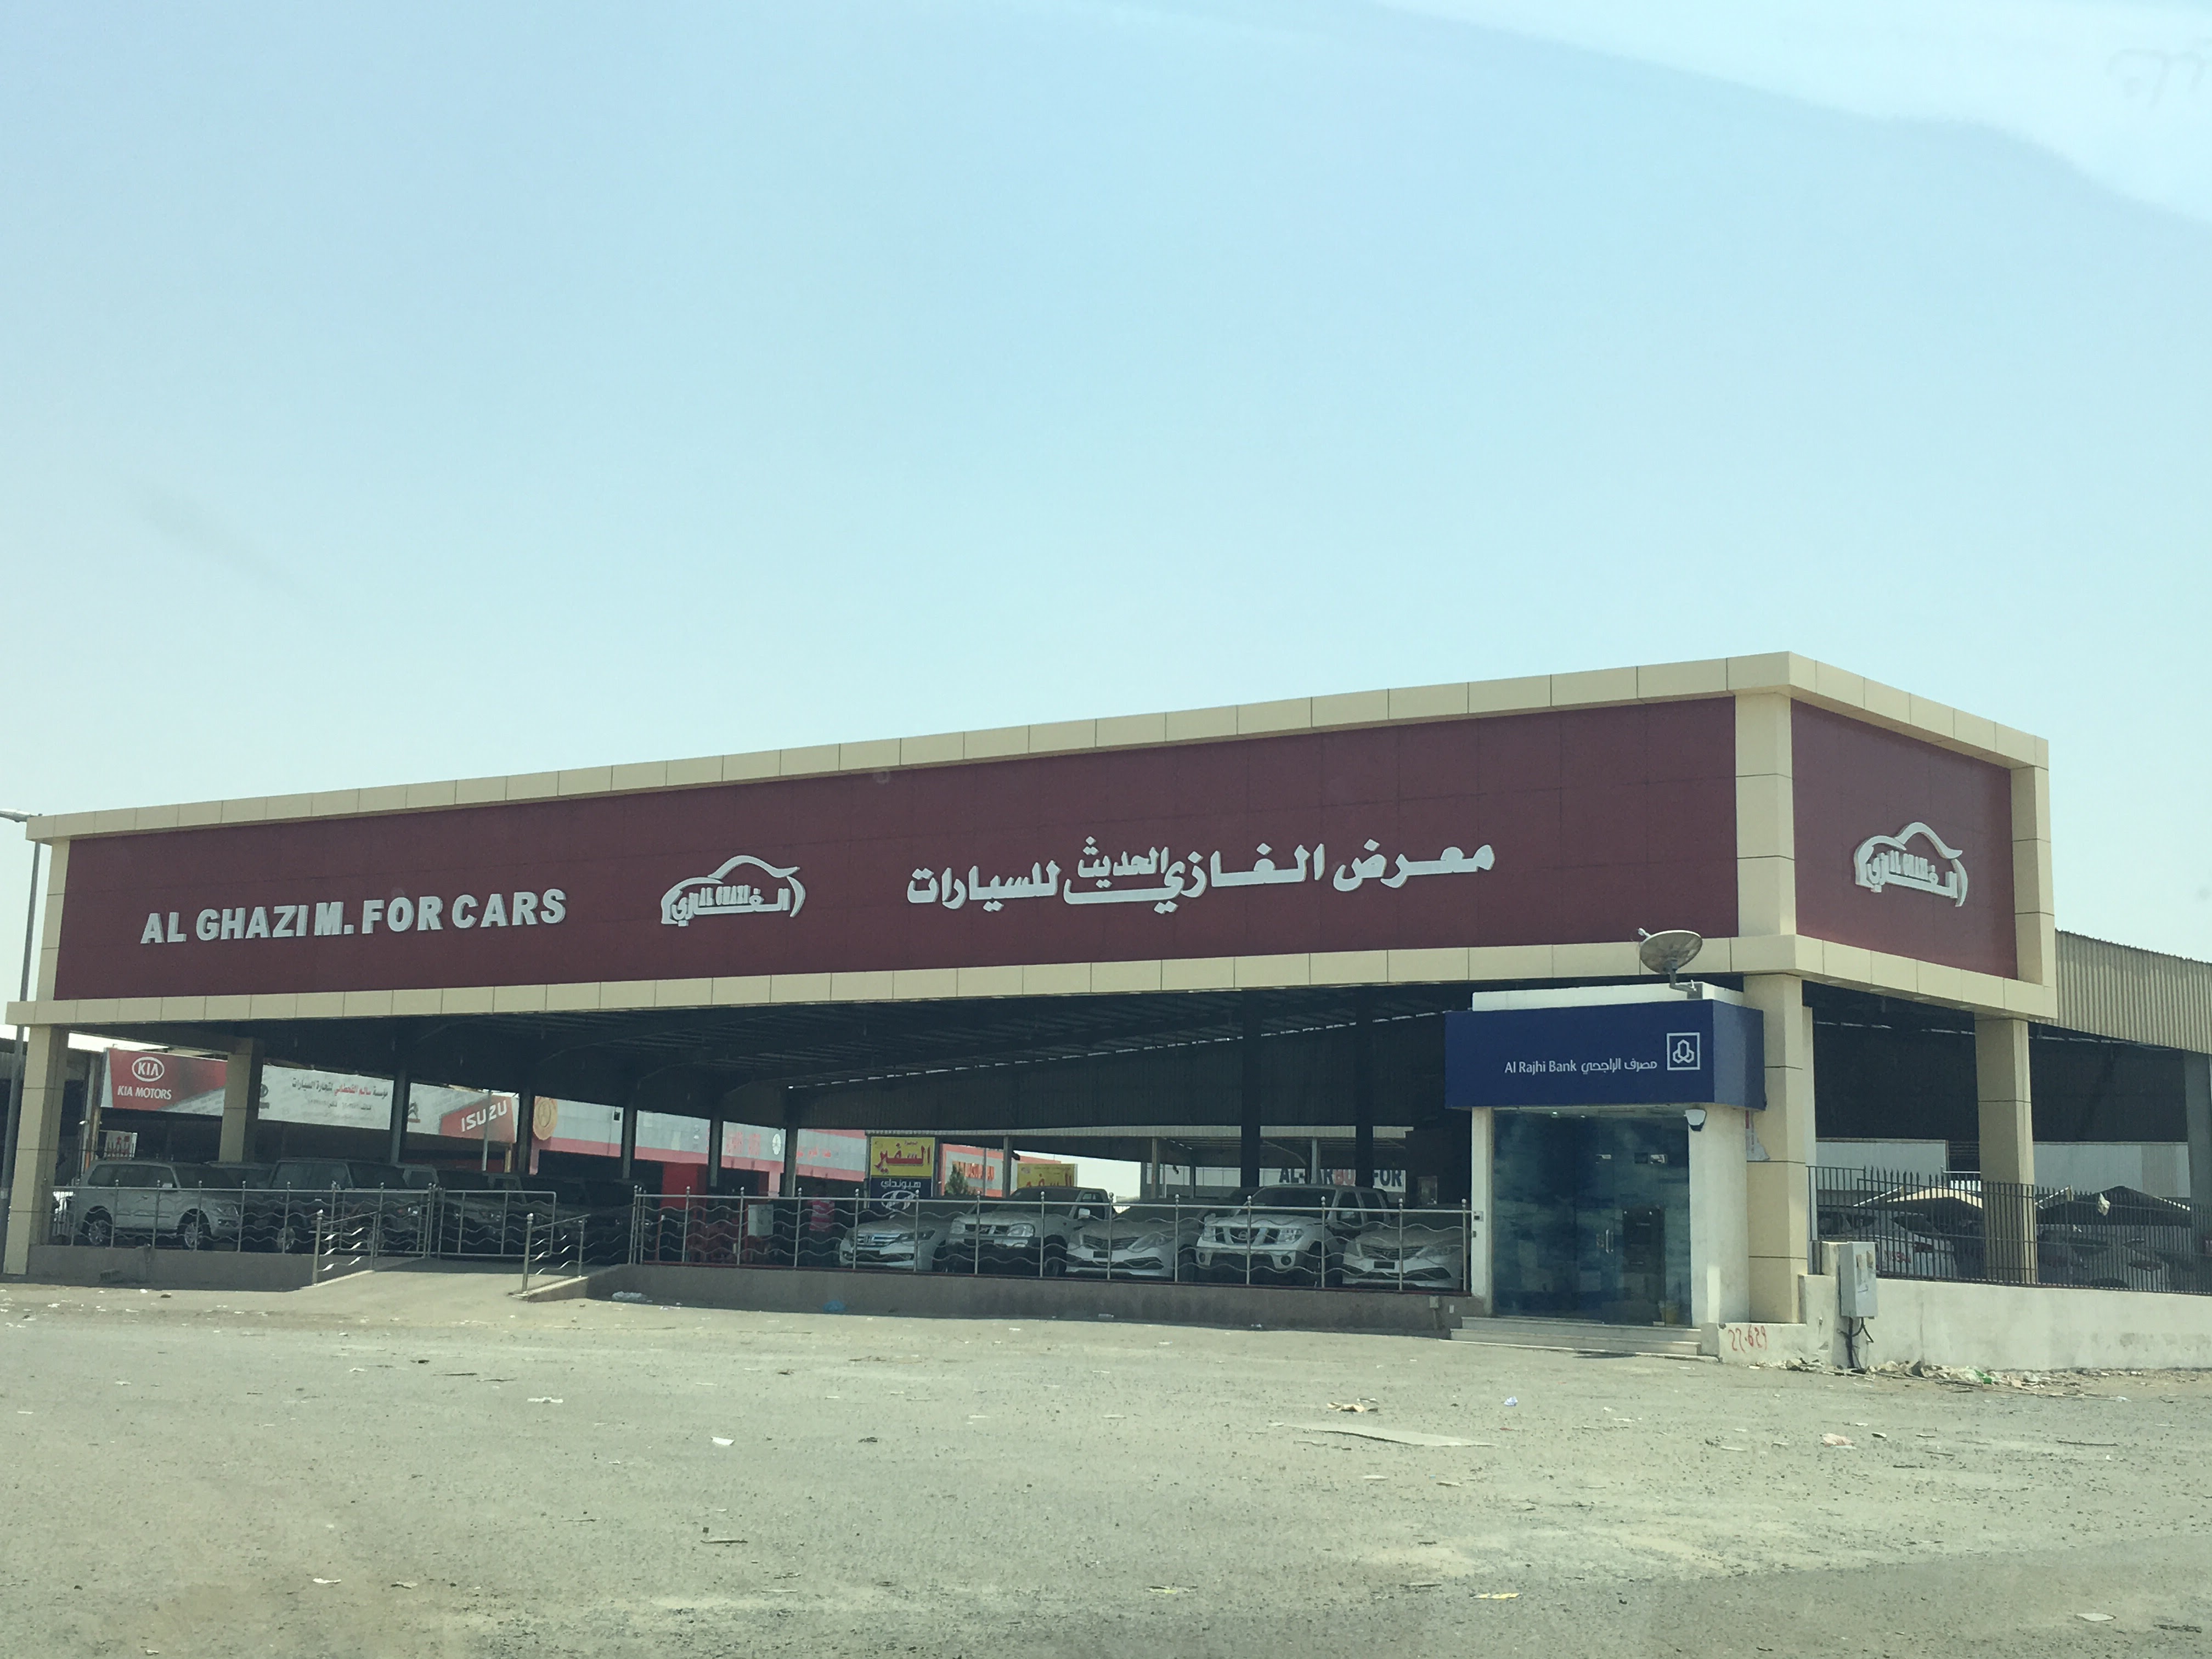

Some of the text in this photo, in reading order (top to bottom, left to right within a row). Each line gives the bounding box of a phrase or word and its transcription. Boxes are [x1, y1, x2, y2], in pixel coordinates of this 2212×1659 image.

[907, 836, 1495, 914] معرض الغازي الحديث للسيارات
[140, 889, 566, 944] AL GHAZI M. FOR CARS
[138, 1062, 159, 1076] KIA
[1504, 1059, 1577, 1075] Al Rajhi Bank
[1581, 1058, 1657, 1075] مصرف الراجحي
[117, 1086, 172, 1100] KIA MOTORS
[461, 1100, 507, 1132] ISUZU
[874, 1142, 931, 1173] السفير
[881, 1178, 921, 1189] هيونداي
